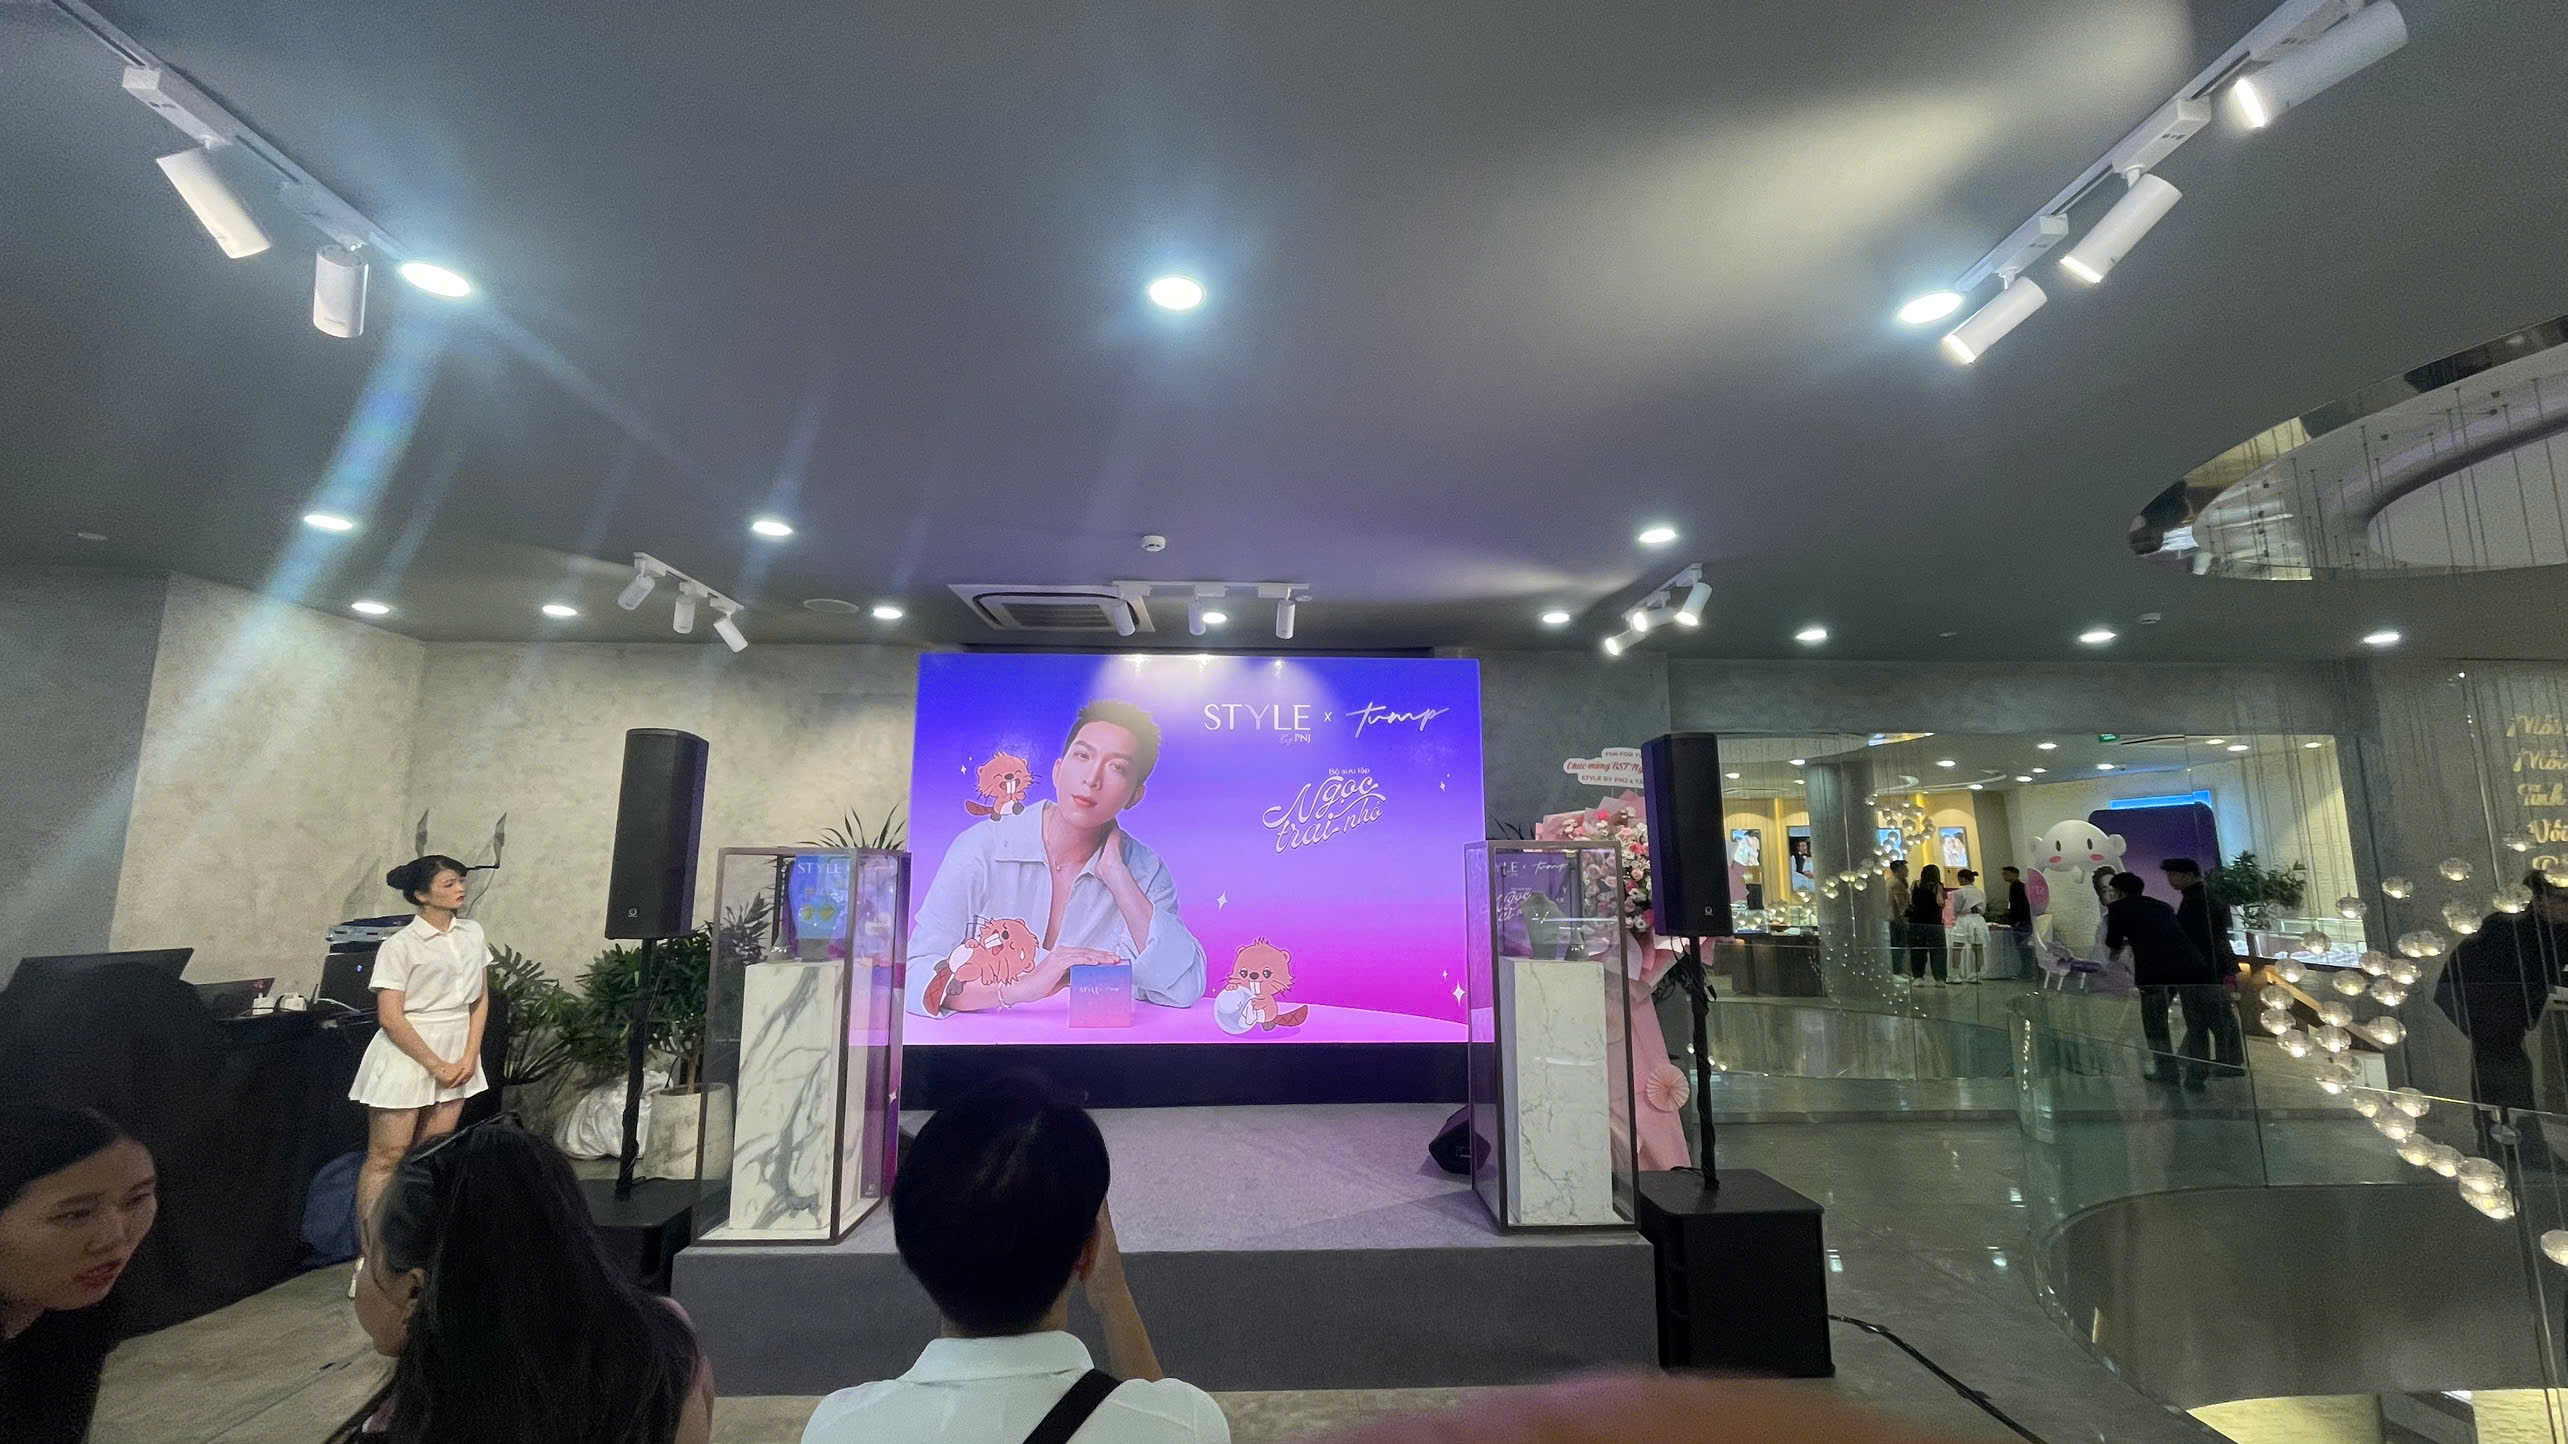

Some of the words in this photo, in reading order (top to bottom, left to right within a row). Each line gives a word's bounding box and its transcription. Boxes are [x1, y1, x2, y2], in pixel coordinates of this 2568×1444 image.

[1203, 703, 1311, 730] STYLE
[1294, 733, 1311, 744] PNJ
[1262, 775, 1380, 829] Ngọc
[1275, 812, 1340, 853] trai
